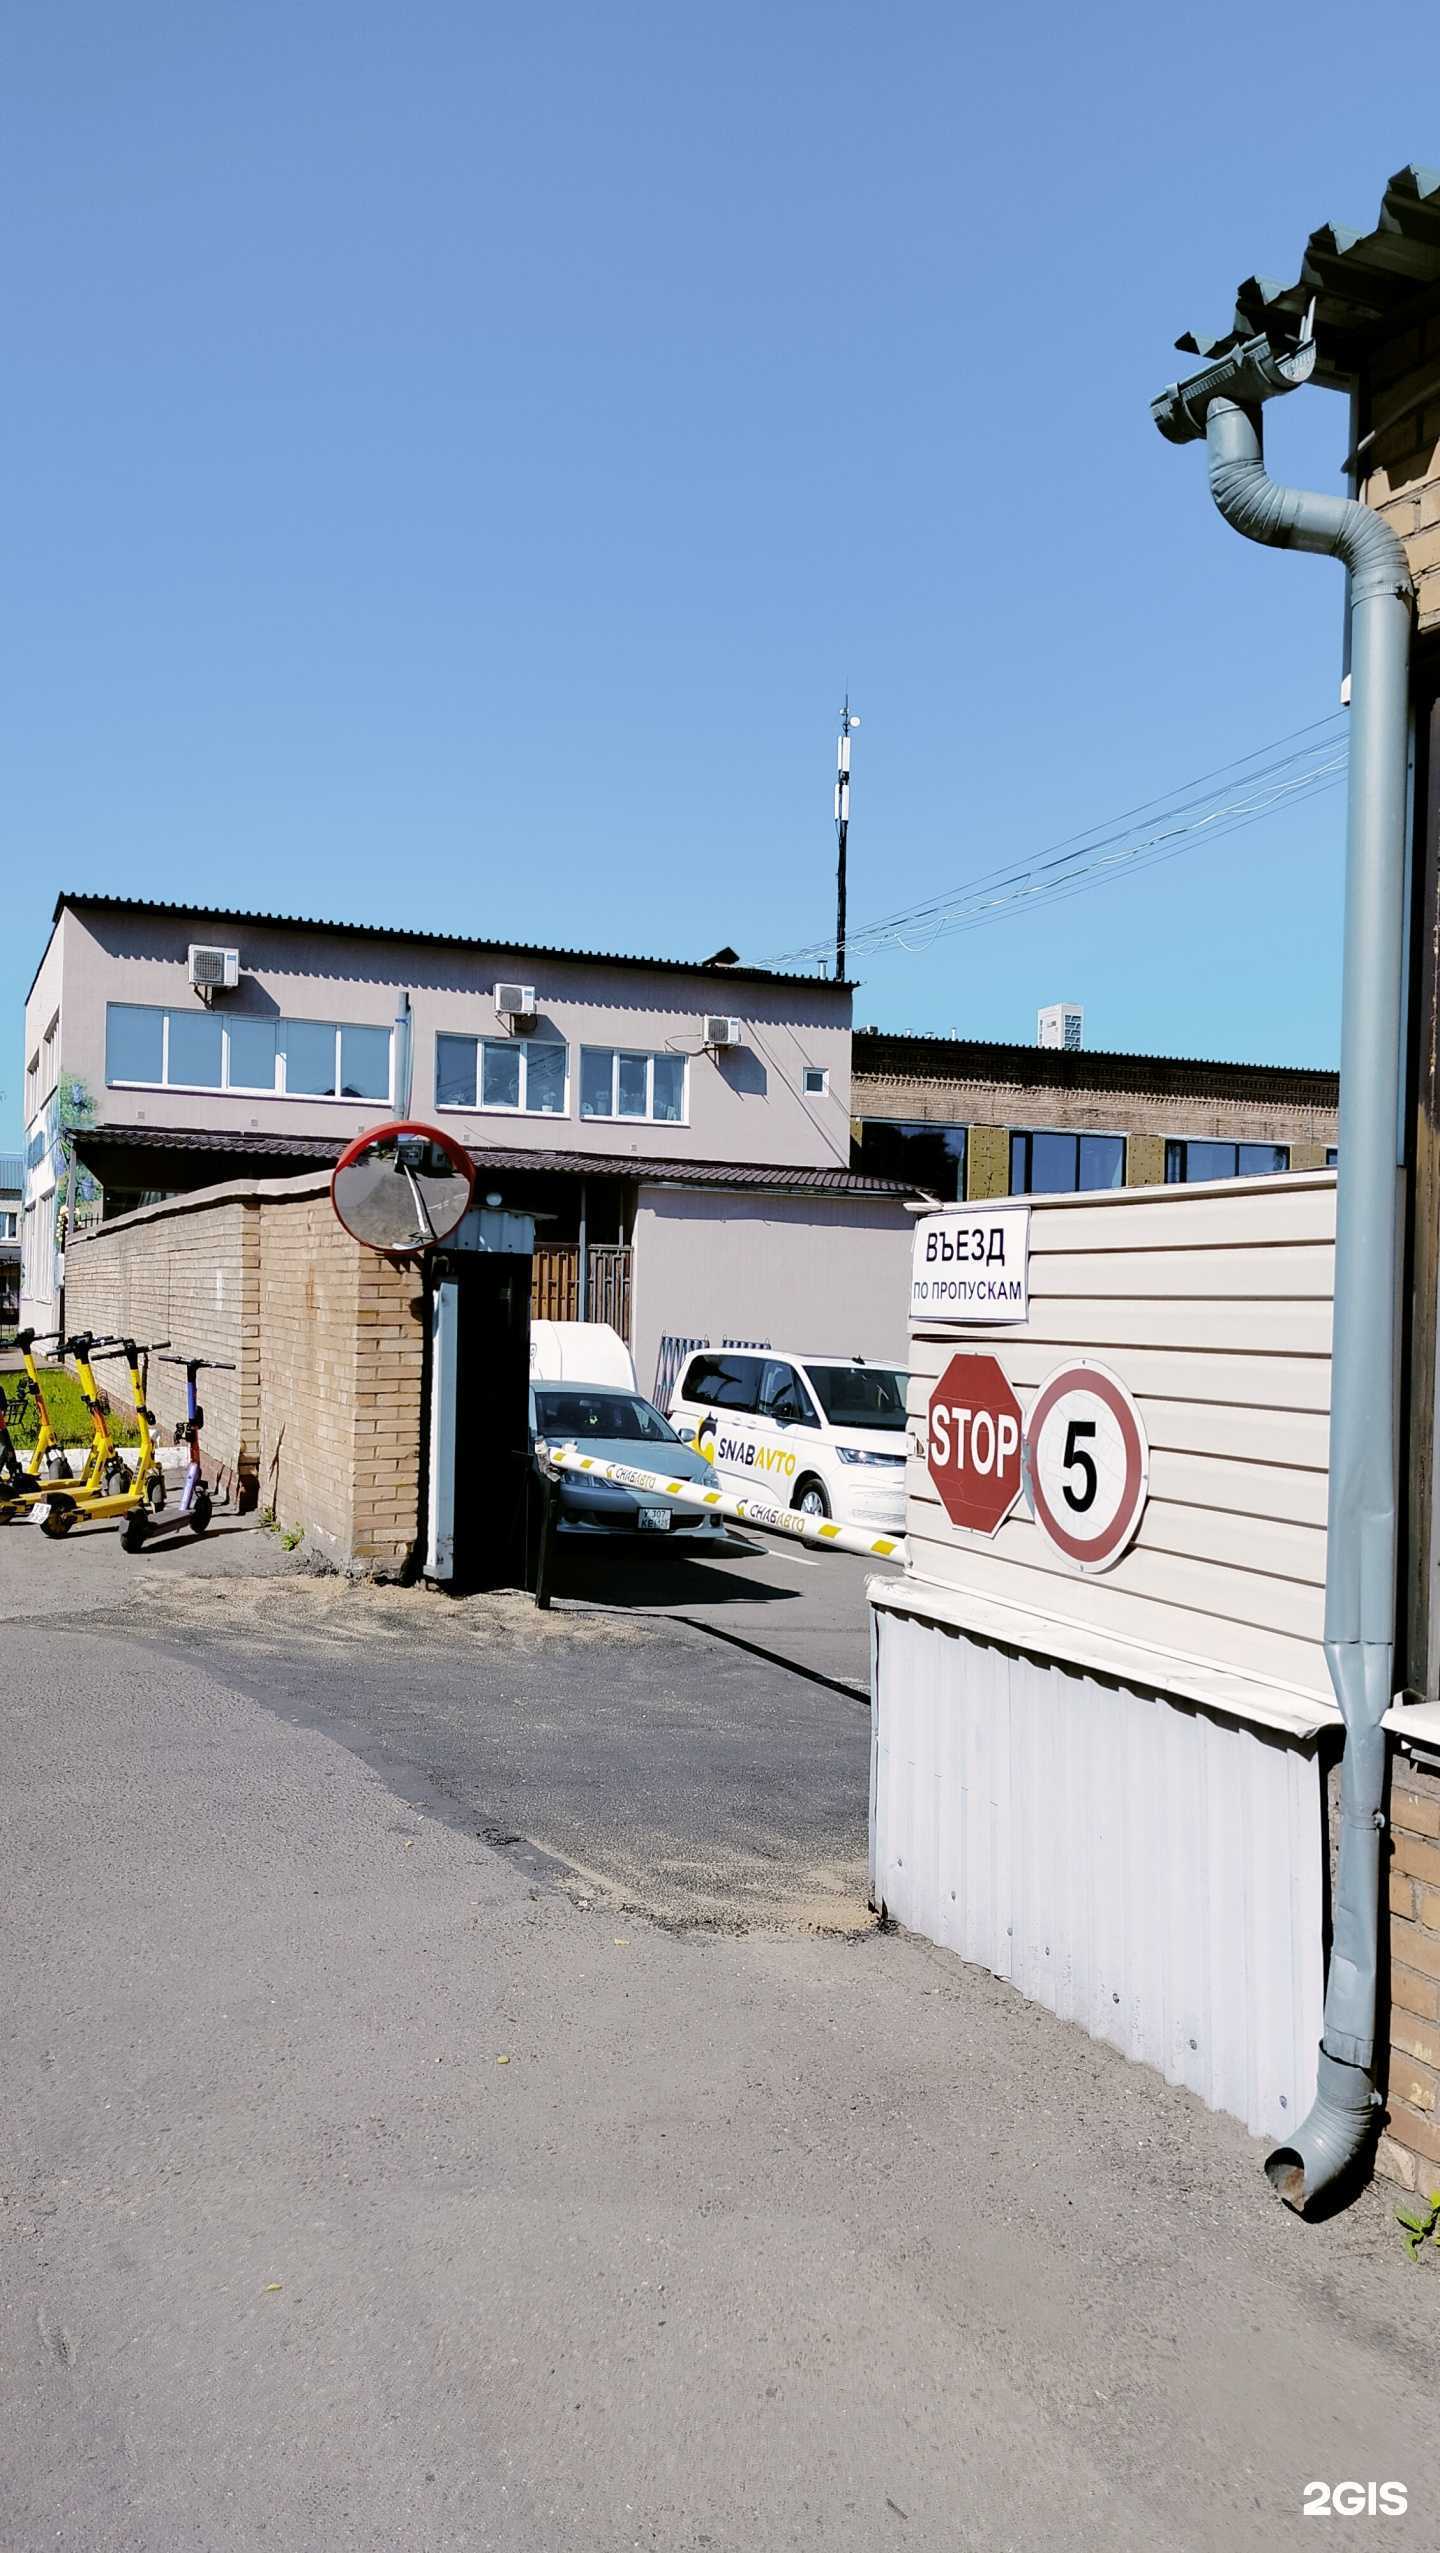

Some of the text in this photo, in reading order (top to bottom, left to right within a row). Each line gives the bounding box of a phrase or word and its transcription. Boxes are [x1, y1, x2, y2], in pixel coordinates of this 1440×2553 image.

[926, 1228, 1005, 1267] ВЪЕЗД
[913, 1281, 1022, 1300] ПО ПРОПУСКАМ
[718, 1438, 796, 1477] SNABAVTO
[930, 1403, 1019, 1478] STOP
[1062, 1420, 1098, 1513] 5
[750, 1504, 805, 1532] СНАБАВТО
